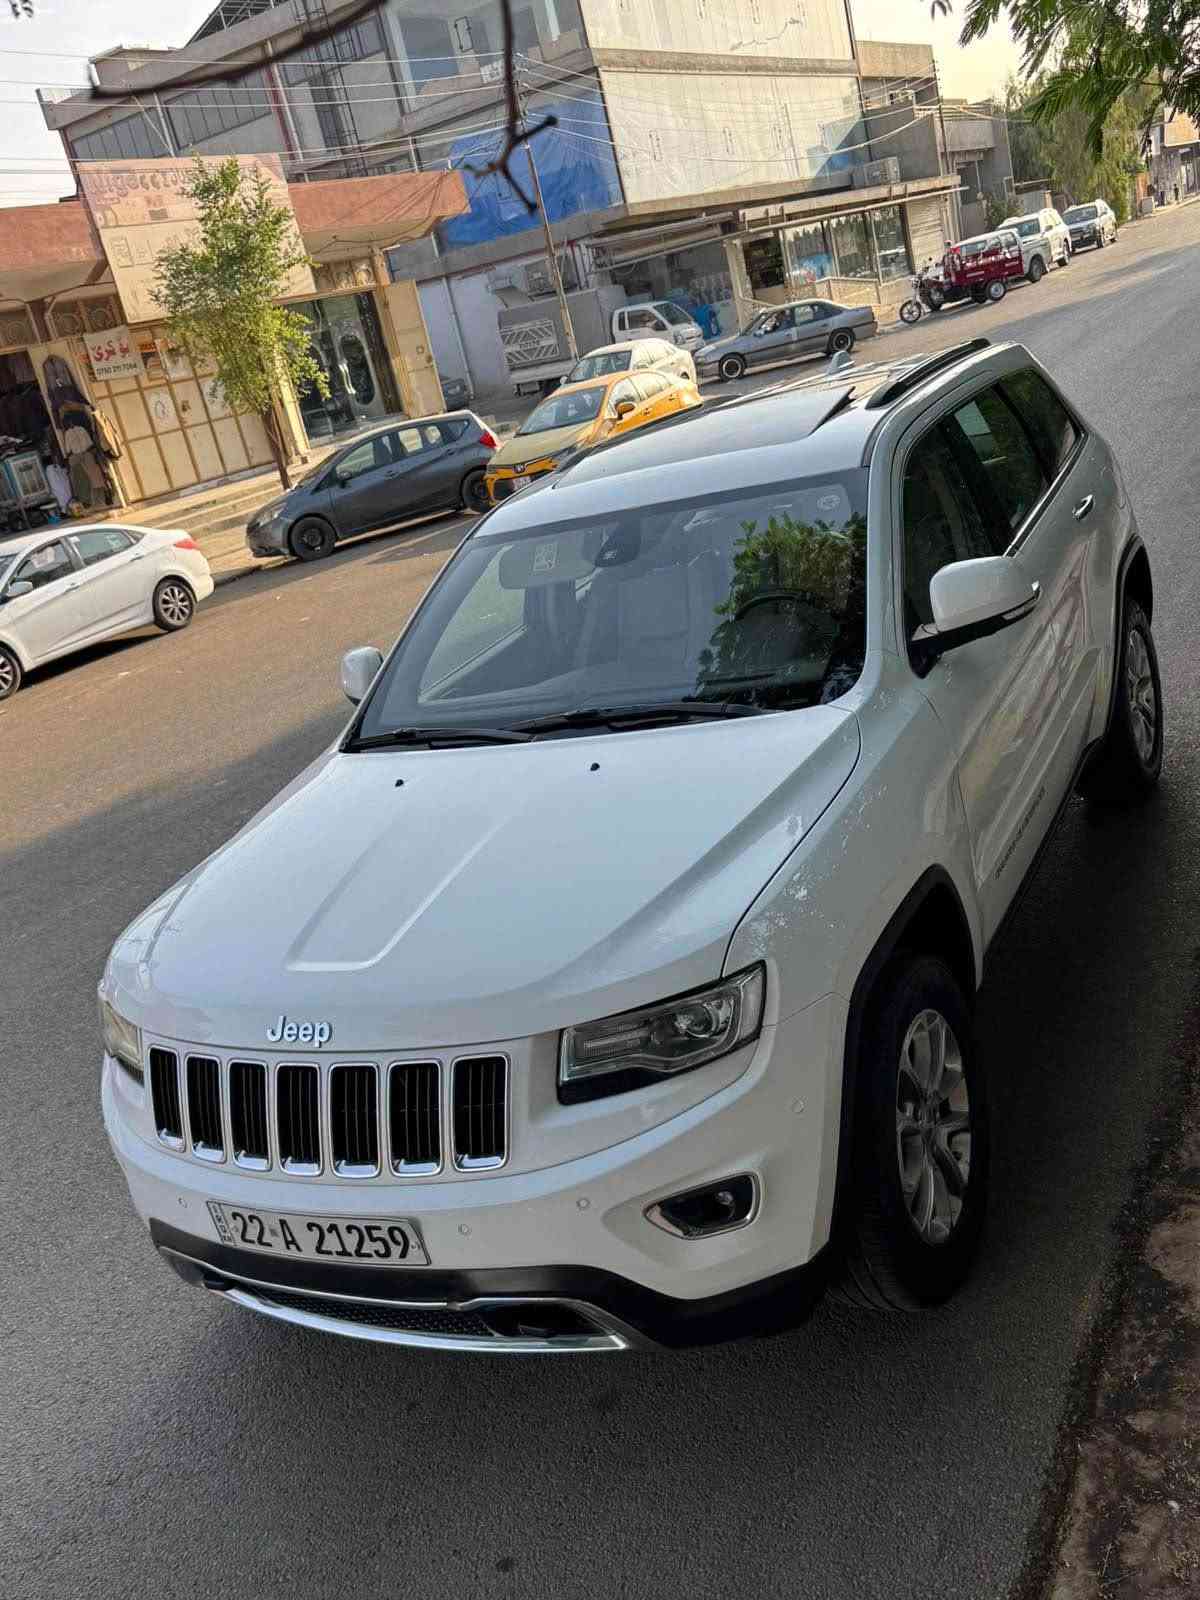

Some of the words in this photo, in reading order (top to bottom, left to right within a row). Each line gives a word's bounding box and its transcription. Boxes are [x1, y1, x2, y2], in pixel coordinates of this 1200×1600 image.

[266, 1015, 332, 1048] Jeep
[231, 1211, 272, 1247] 22
[279, 1218, 303, 1252] A
[306, 1221, 410, 1259] 21259
